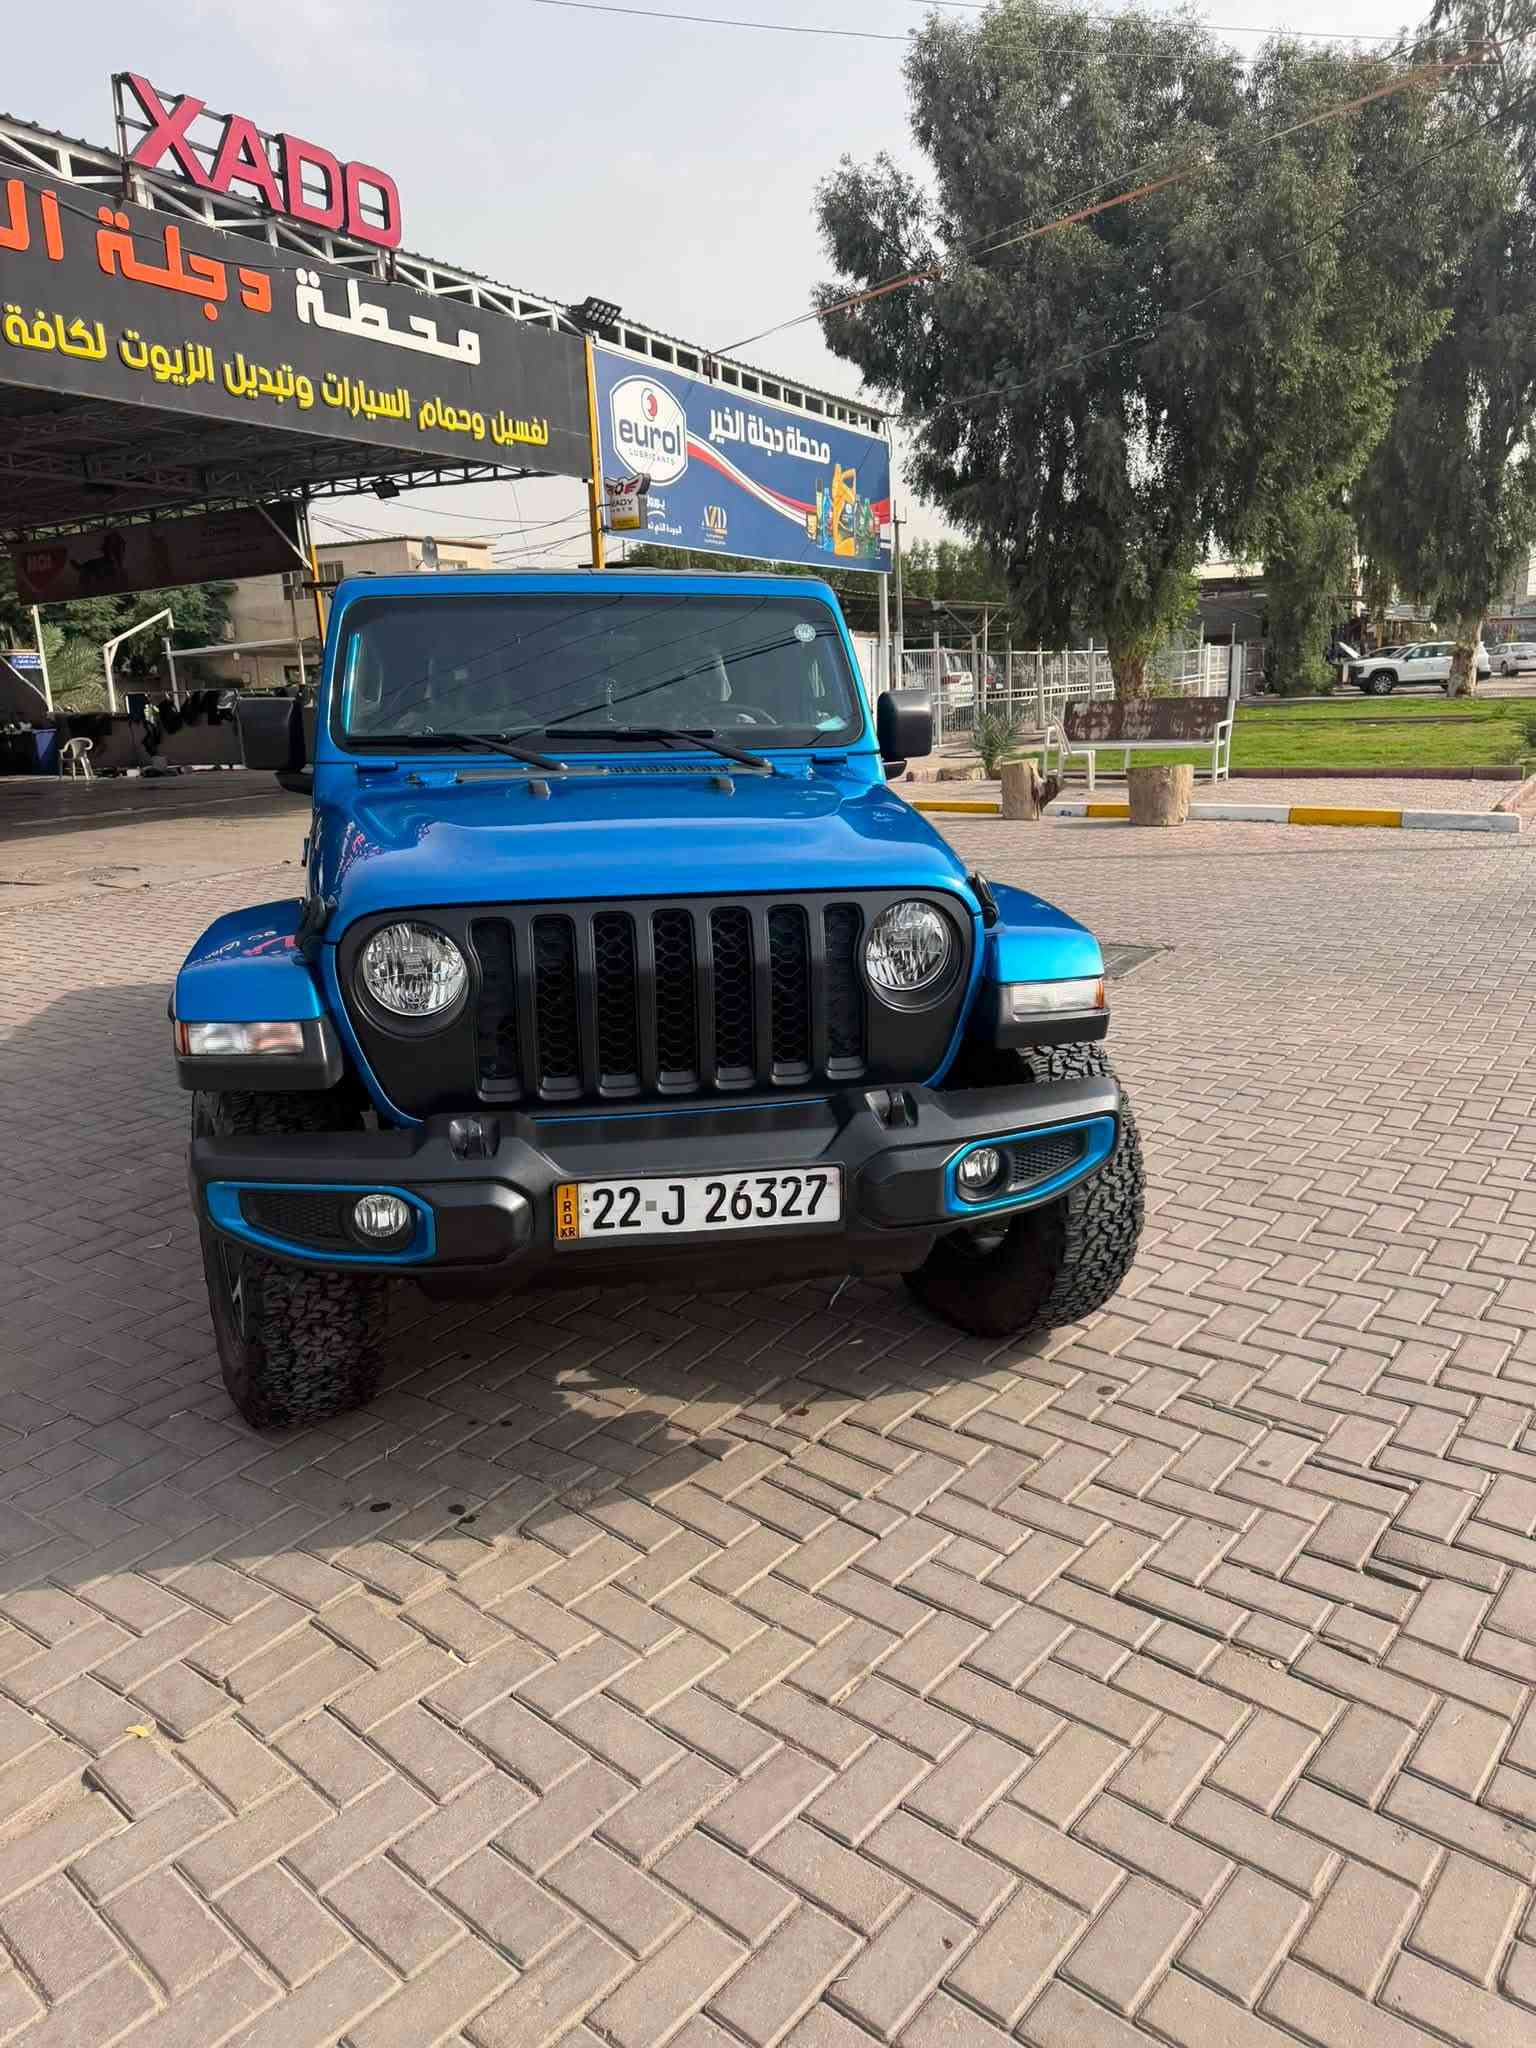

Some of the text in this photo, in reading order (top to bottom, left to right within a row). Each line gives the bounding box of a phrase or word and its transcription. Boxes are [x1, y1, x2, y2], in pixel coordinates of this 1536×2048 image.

[127, 73, 402, 249] XADO
[96, 206, 272, 321] دجلة
[295, 267, 481, 366] محطة
[4, 303, 549, 446] لغسيل وحمام السيارات وتبديل الزيوت لكافة
[618, 418, 681, 457] eurol
[708, 406, 831, 465] محطة دجلة الخير
[592, 1174, 828, 1230] 22 J 26327
